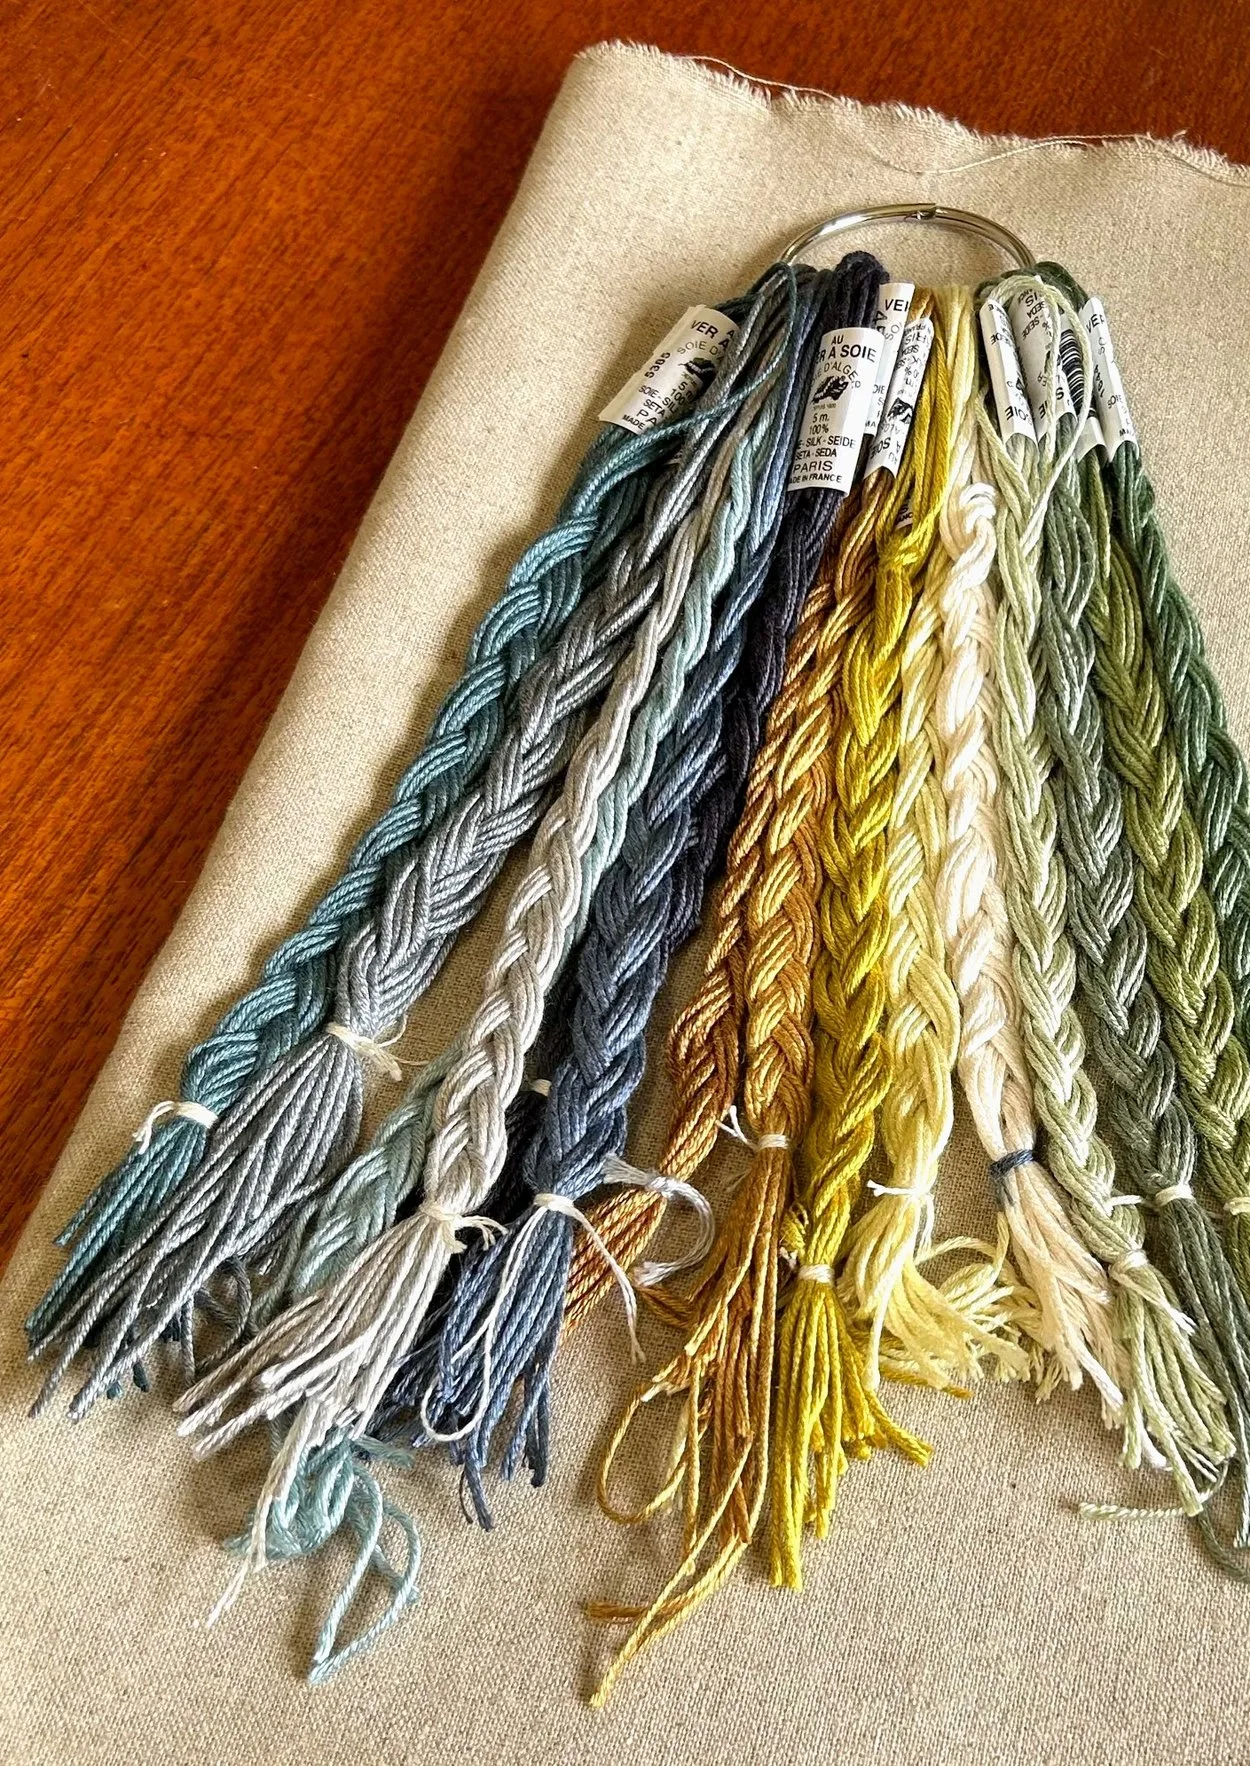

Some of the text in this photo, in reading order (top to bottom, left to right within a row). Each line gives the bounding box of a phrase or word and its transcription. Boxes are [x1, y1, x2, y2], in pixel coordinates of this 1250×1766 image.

[690, 320, 719, 339] VER
[831, 334, 844, 345] AU
[677, 340, 707, 355] SOIE
[828, 346, 836, 359] A
[840, 344, 877, 363] SOIE
[643, 399, 666, 418] SETA
[662, 397, 677, 414] SIL
[622, 414, 646, 430] MADE
[812, 412, 818, 423] 5
[805, 436, 822, 447] SILK
[827, 435, 856, 449] SEIDE
[815, 447, 837, 457] SEDA
[793, 460, 833, 473] PARIS
[808, 472, 842, 483] FRANCE
